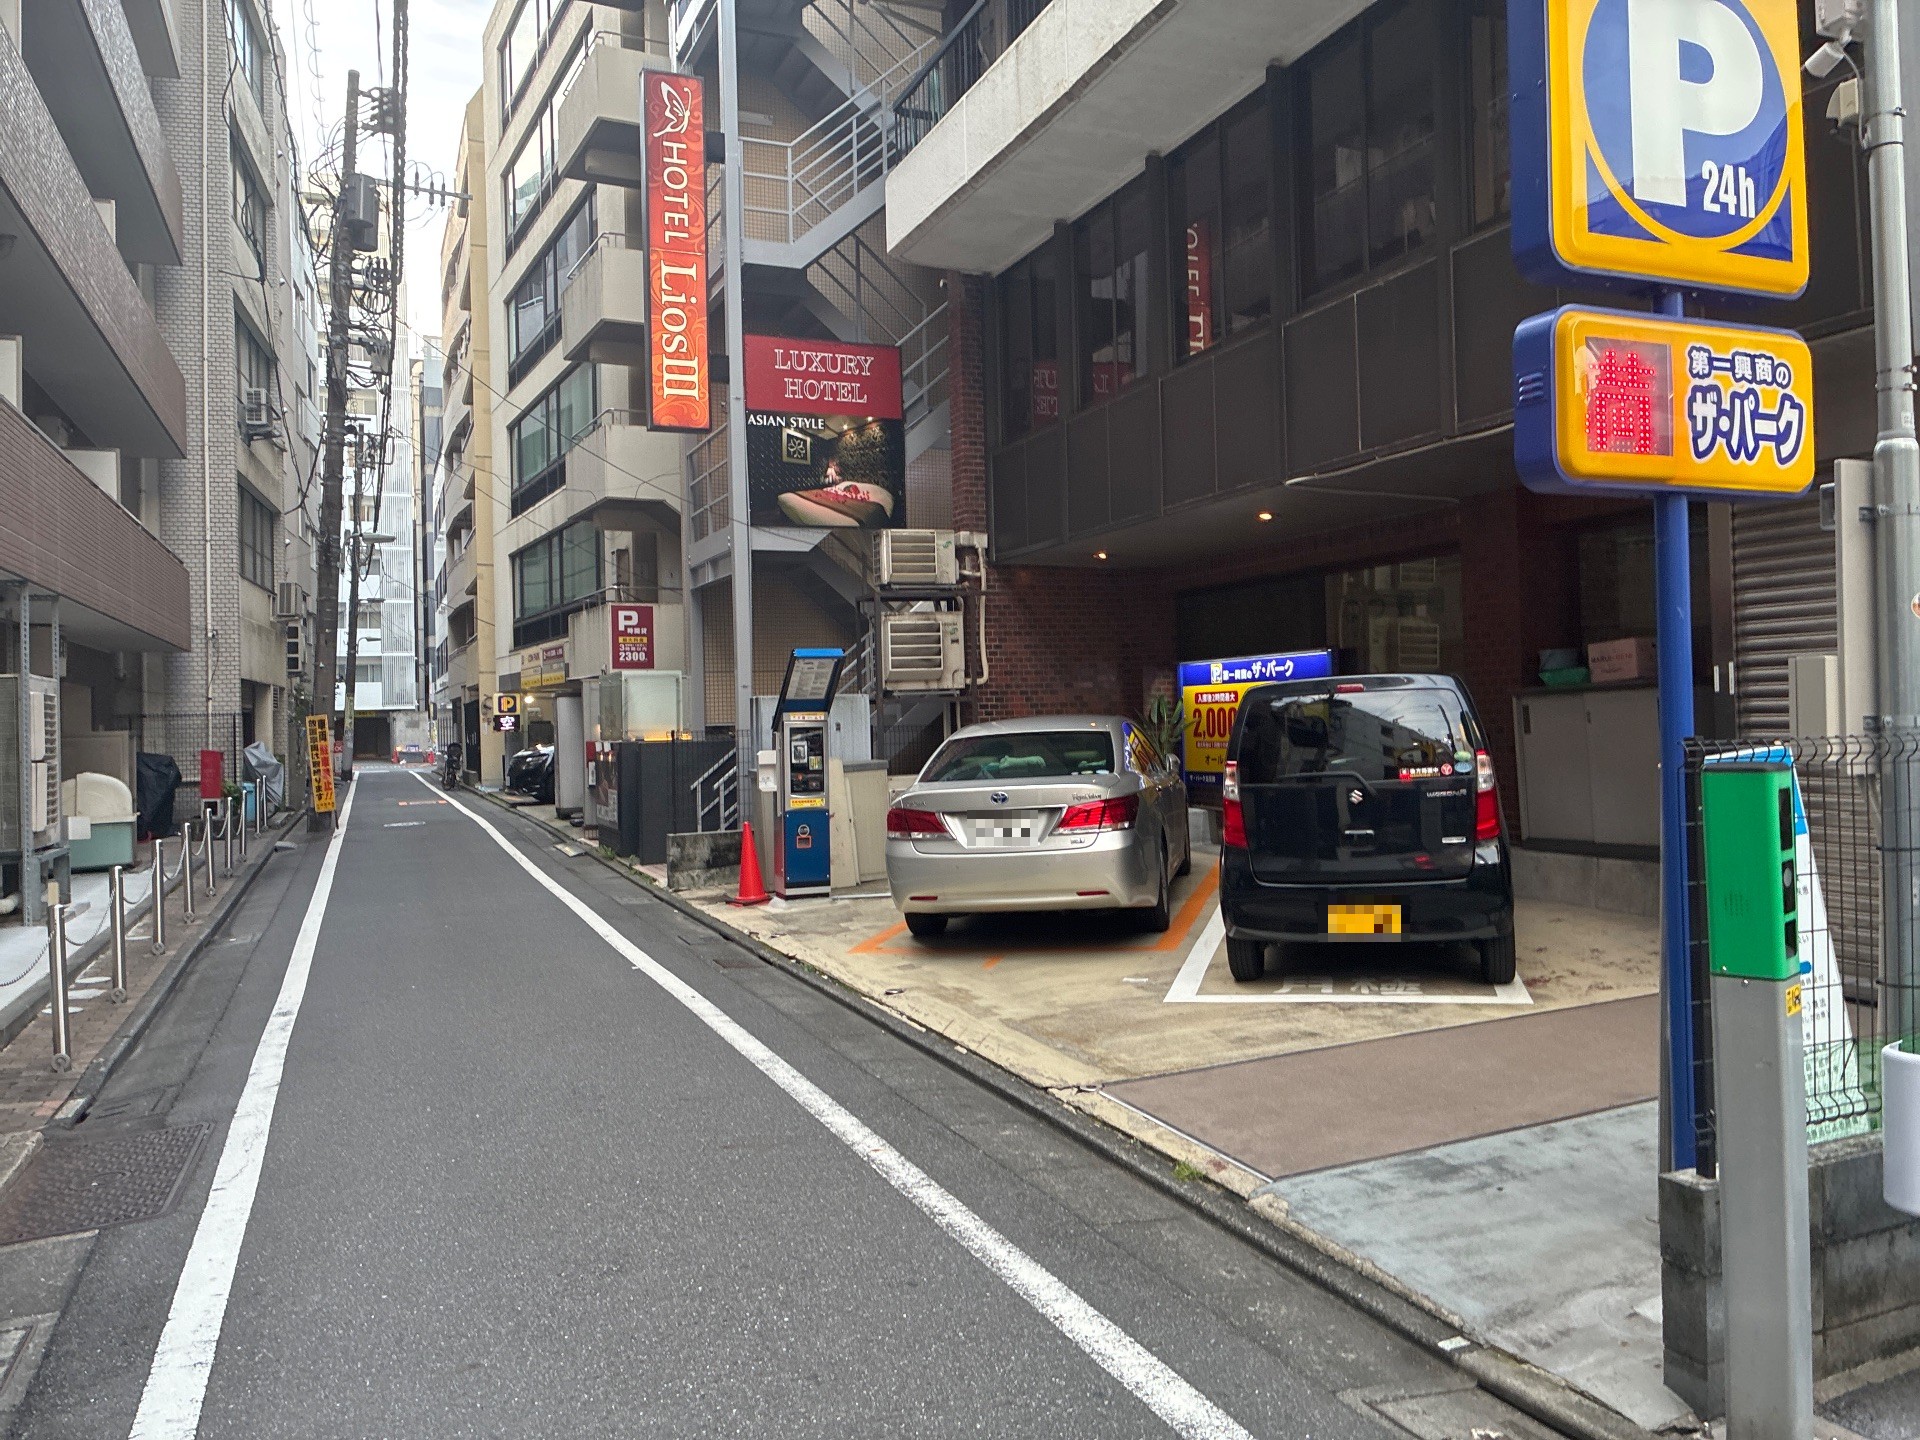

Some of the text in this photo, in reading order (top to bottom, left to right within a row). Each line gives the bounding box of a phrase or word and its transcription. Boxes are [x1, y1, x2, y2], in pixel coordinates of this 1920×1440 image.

[1628, 0, 1763, 207] P
[662, 141, 688, 244] HOTEL
[1701, 159, 1756, 219] 24h
[774, 349, 874, 376] LUXURY
[1688, 347, 1791, 387] 第一興商の
[784, 378, 868, 404] HOTEL
[747, 414, 825, 430] ASIAN STYLE
[1691, 389, 1804, 464] ザ・パーク
[618, 610, 639, 632] P
[1192, 706, 1238, 739] 2,000
